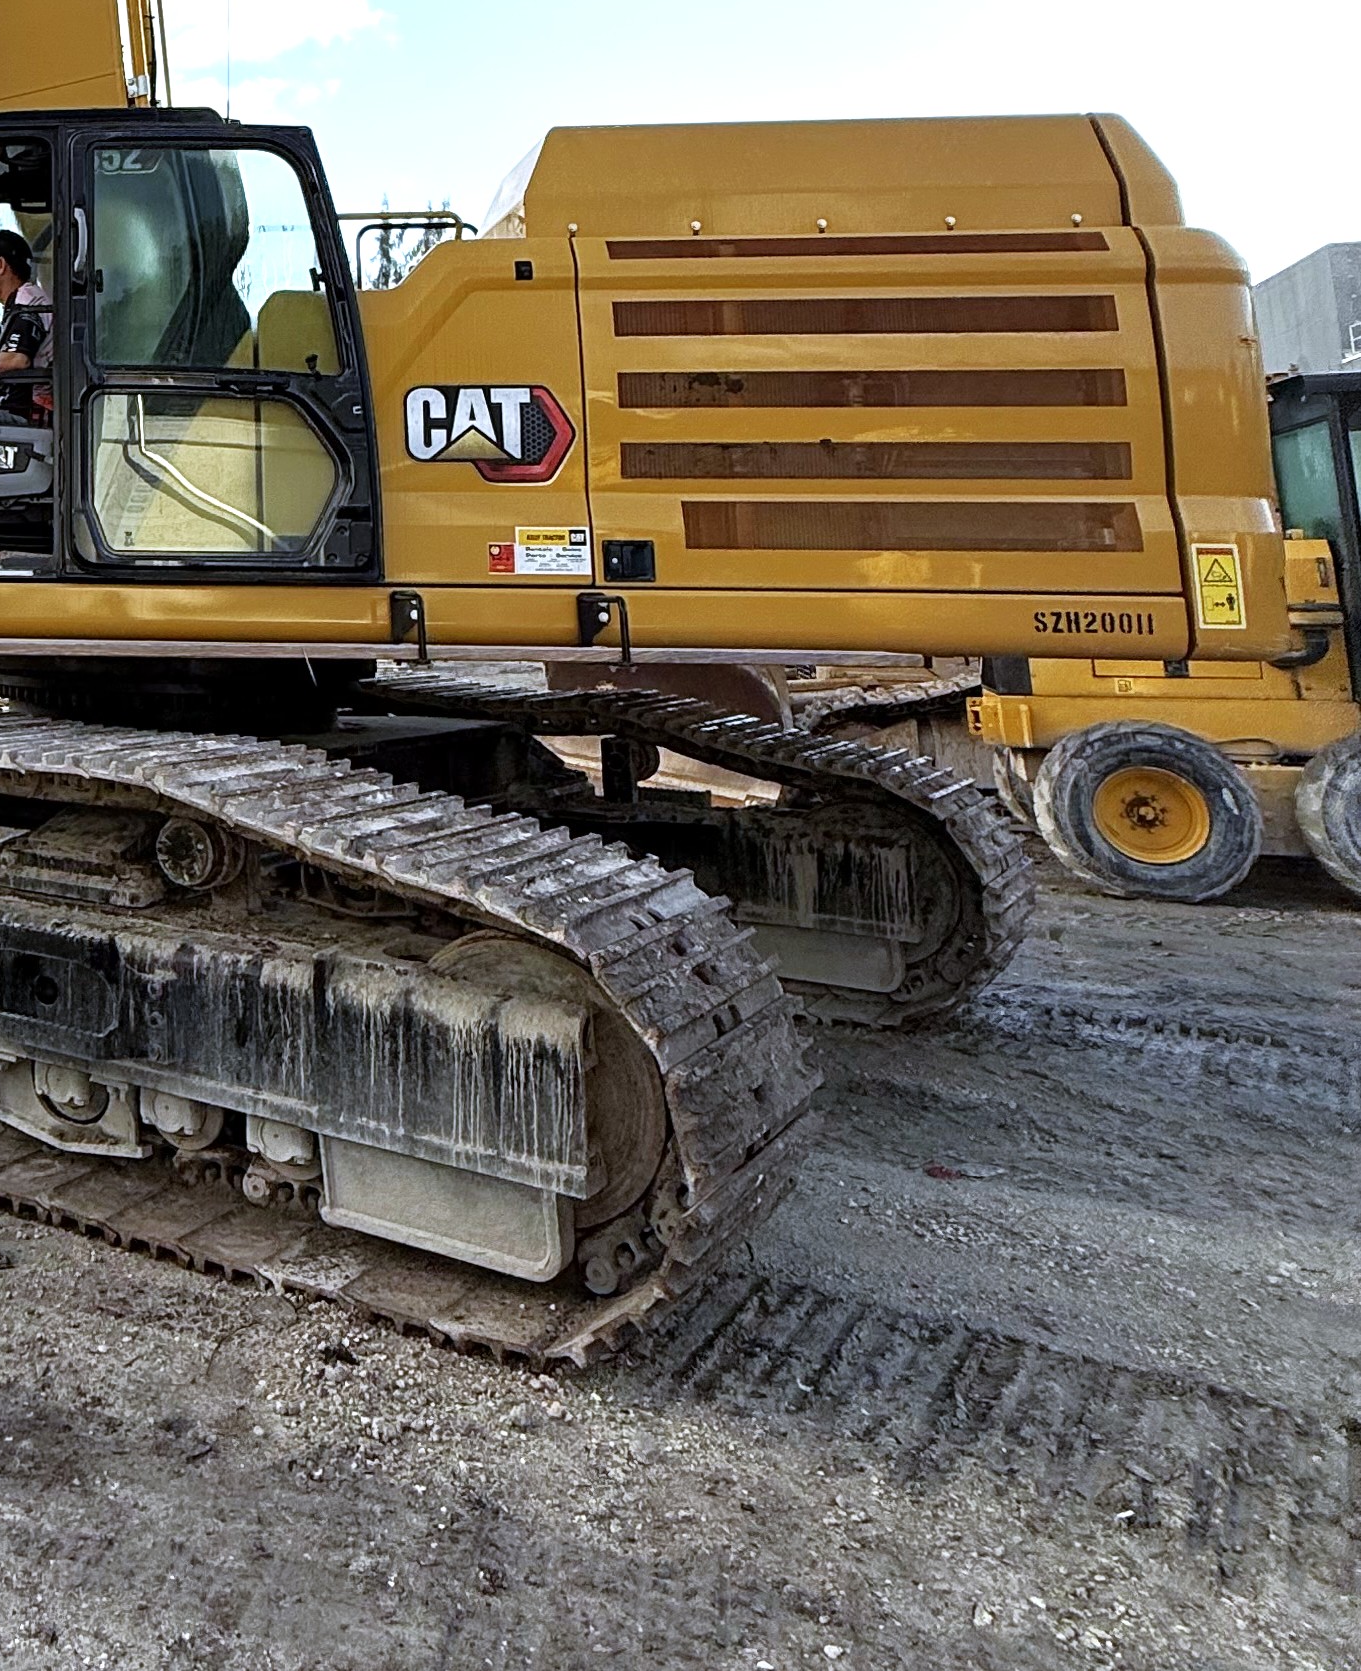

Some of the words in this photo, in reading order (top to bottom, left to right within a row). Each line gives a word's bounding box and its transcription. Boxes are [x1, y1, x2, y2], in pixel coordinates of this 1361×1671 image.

[94, 150, 142, 170] 52
[406, 387, 531, 460] CAT
[1034, 611, 1154, 635] SZH20011
